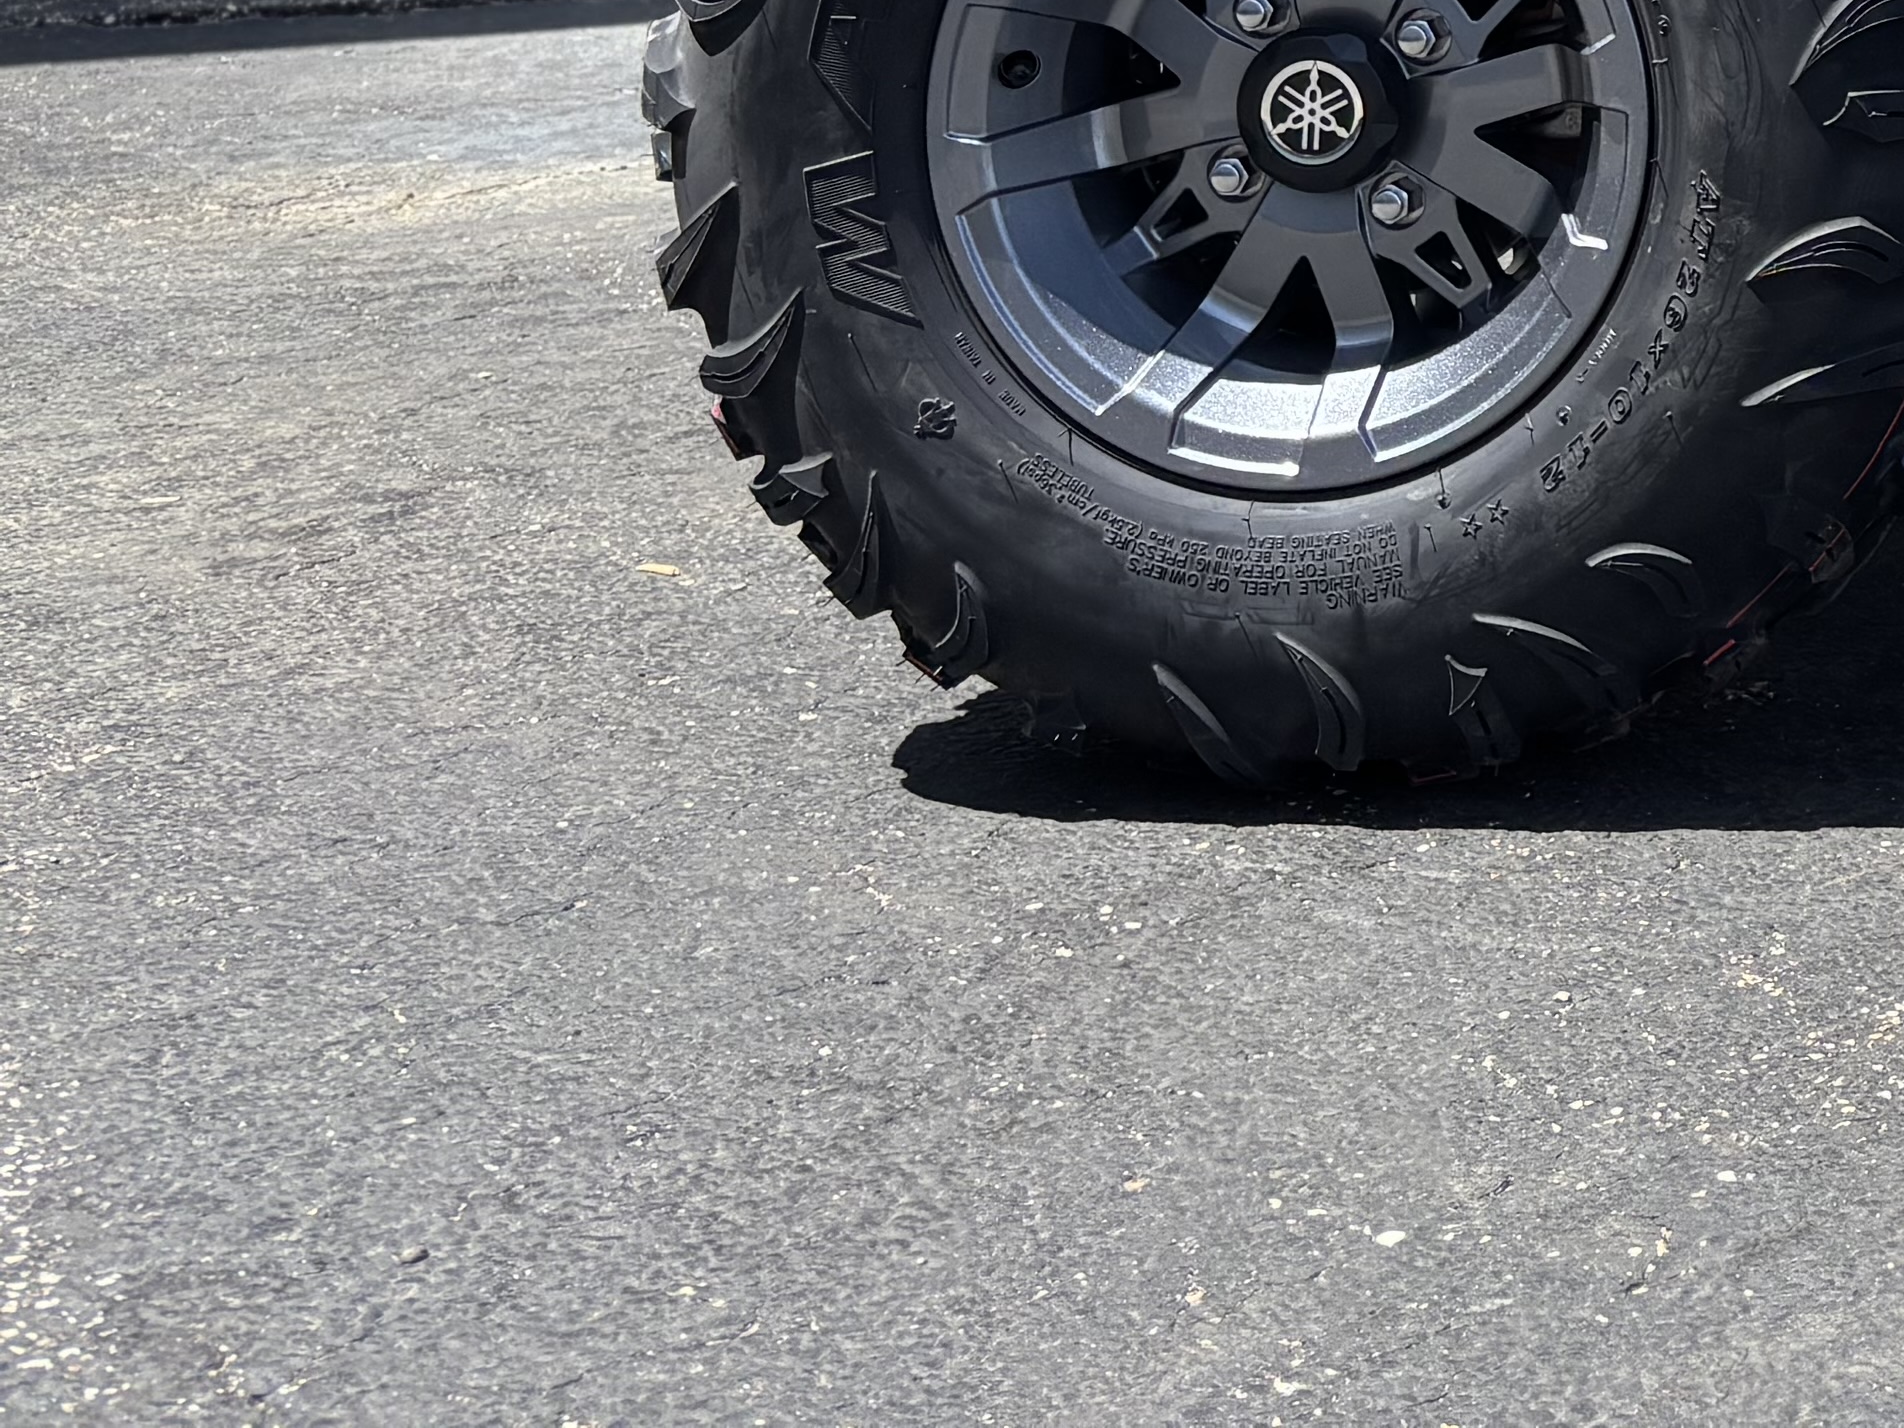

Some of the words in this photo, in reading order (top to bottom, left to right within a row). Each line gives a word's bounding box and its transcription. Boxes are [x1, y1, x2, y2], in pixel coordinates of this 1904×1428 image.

[1034, 455, 1095, 502] TUBELESS
[1291, 530, 1352, 549] SEATING
[1359, 521, 1397, 539] WHEN
[1102, 528, 1189, 569] PRESSURE.
[1180, 540, 1209, 556] 250
[1247, 537, 1287, 550] BEAD
[1344, 542, 1372, 558] NOT
[1378, 533, 1398, 550] DO
[1214, 545, 1272, 564] BEYOND
[1279, 548, 1337, 564] INFLATE
[1336, 549, 1401, 574] MANUAL
[1126, 557, 1200, 589] OWNER'S
[1196, 557, 1286, 580] OPERATING
[1294, 563, 1328, 578] FOR
[1372, 563, 1403, 584] SEE
[1206, 577, 1230, 593] OR
[1239, 580, 1290, 596] LABEL
[1298, 574, 1361, 596] VEHICLE
[1326, 581, 1406, 610] WARNING
